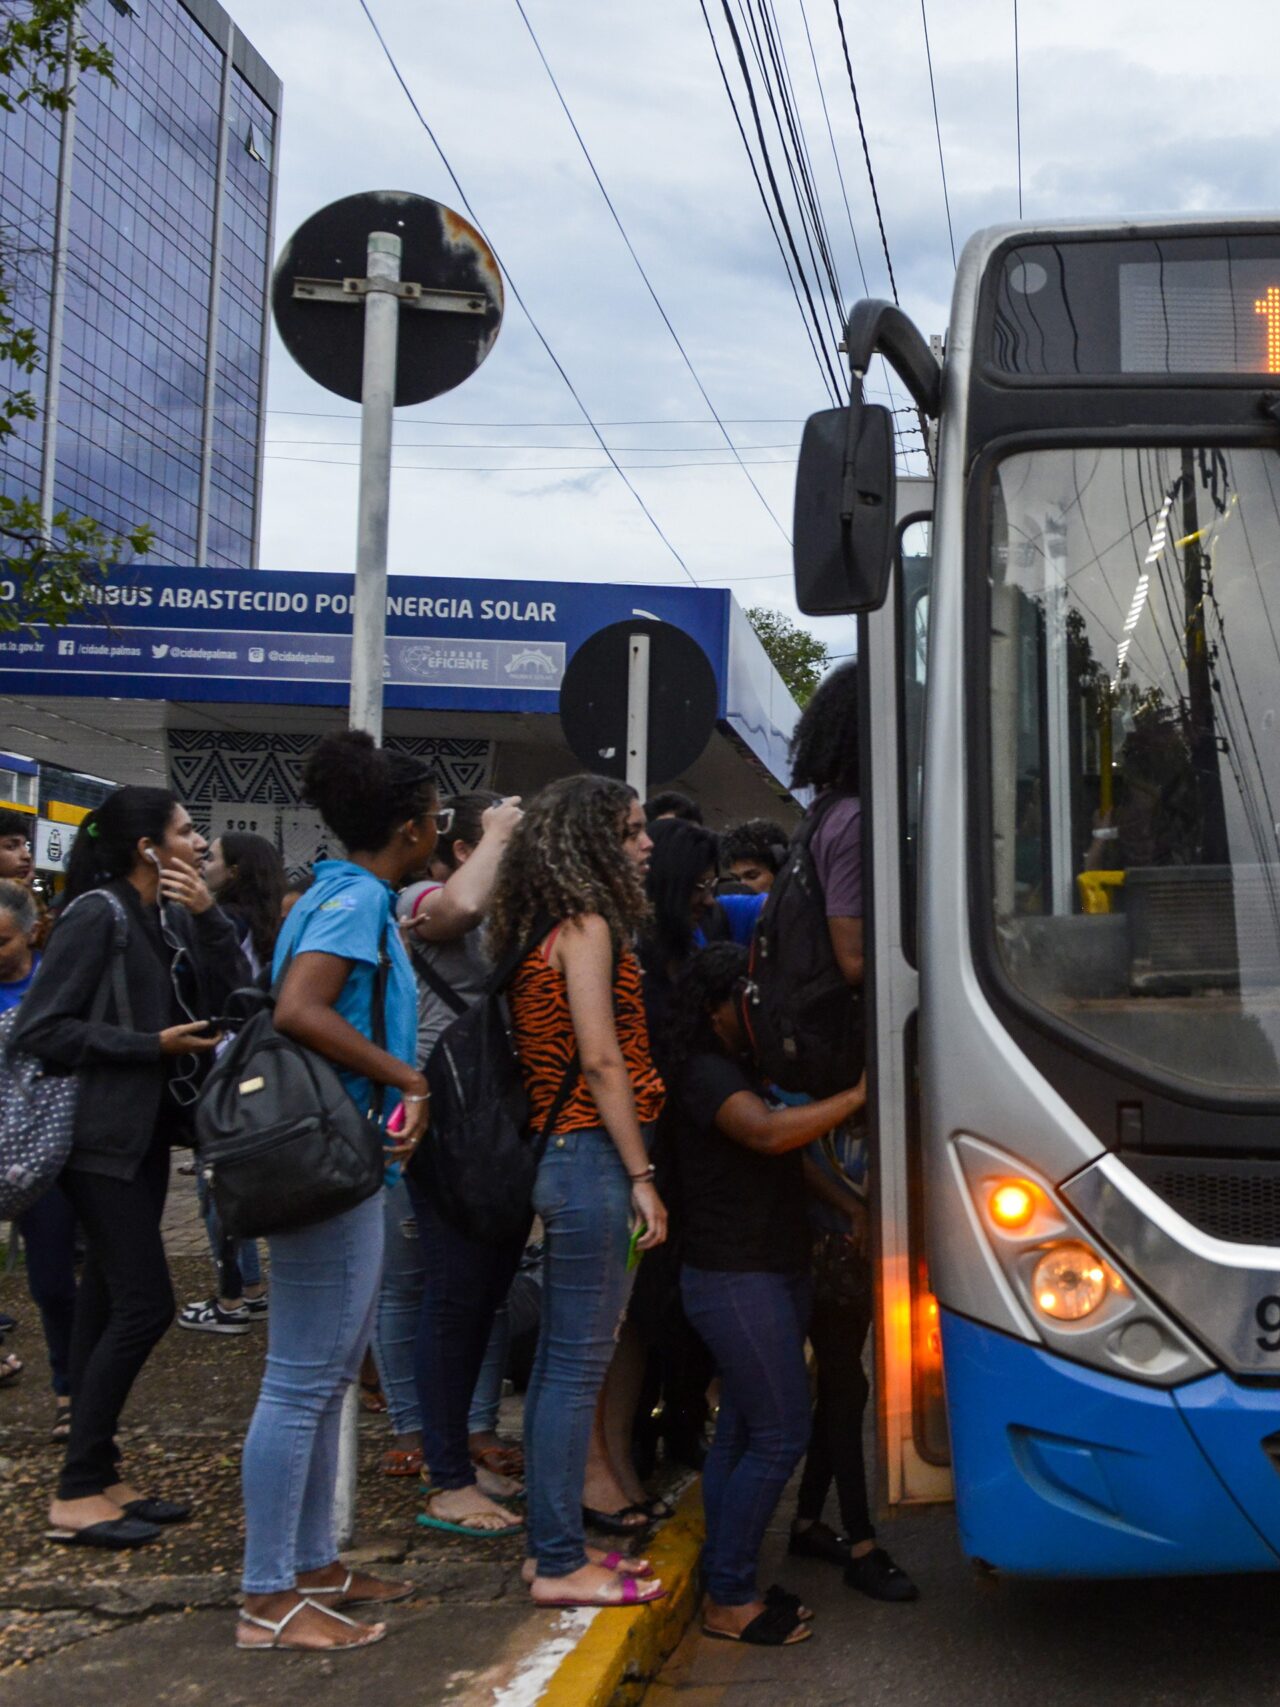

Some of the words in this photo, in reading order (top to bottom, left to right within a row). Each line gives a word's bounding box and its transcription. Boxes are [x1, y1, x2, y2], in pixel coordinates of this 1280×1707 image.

[159, 587, 308, 613] ABASTECIDO
[480, 600, 557, 622] SOLAR
[428, 657, 489, 670] EFICIENTE
